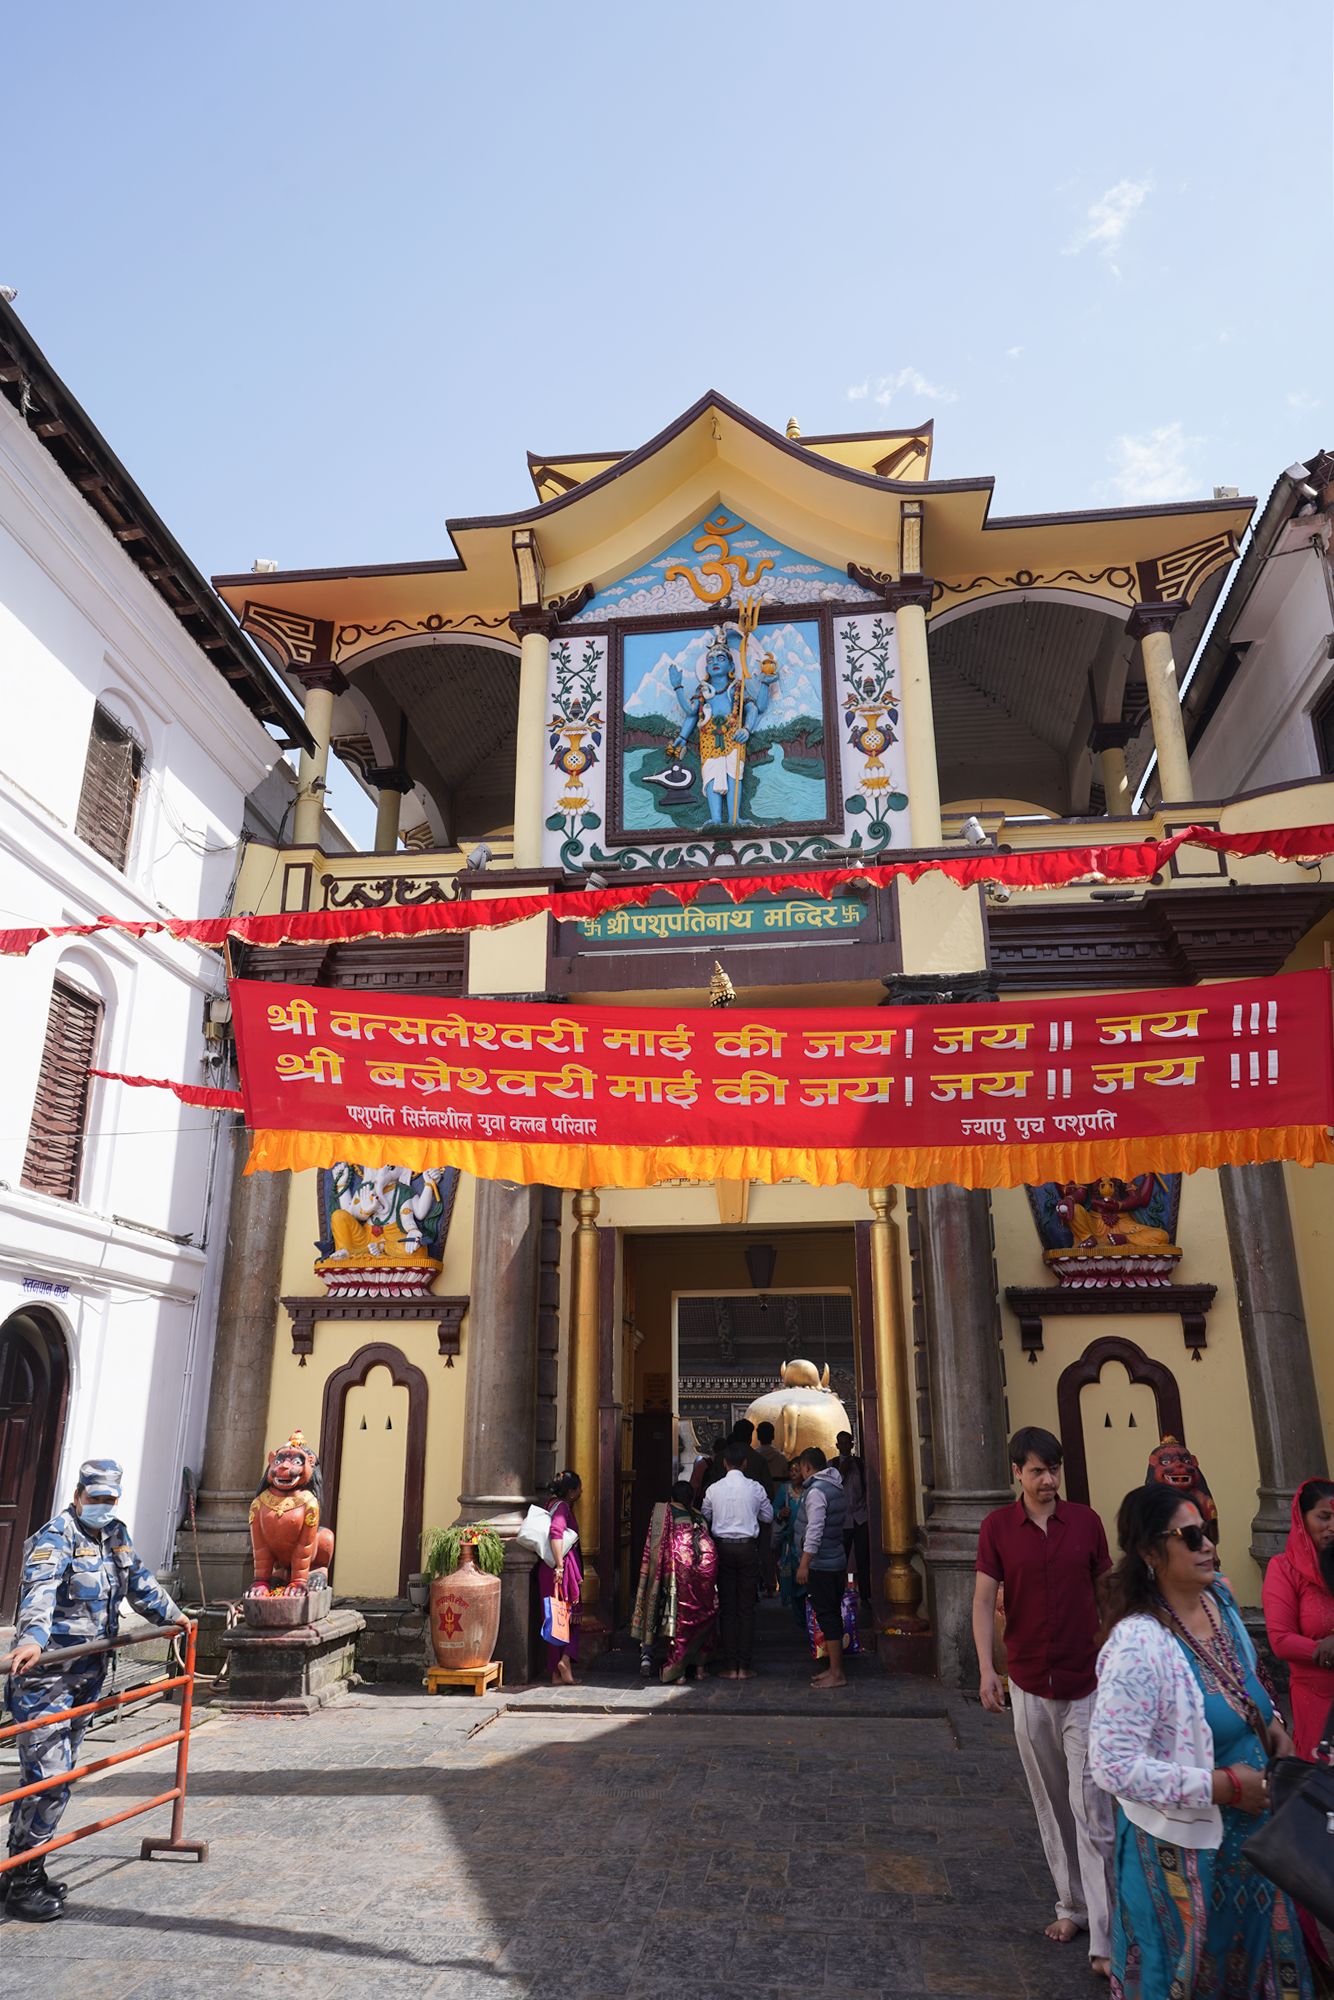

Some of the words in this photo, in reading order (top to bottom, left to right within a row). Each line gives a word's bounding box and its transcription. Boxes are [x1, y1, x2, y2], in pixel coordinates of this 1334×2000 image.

[764, 900, 839, 928] मन्दिर
[267, 998, 318, 1036] श्री
[329, 1010, 588, 1054] वत्सलेश्वरी
[602, 1023, 695, 1061] माई
[713, 1023, 788, 1058] की
[275, 1046, 345, 1085] श्री
[365, 1056, 598, 1100] बज्रेश्वरी
[606, 1068, 702, 1110] माई
[712, 1069, 790, 1106] की
[346, 1103, 395, 1130] पशुपति
[477, 1112, 506, 1136] युवा
[510, 1115, 547, 1133] क्लब
[551, 1112, 598, 1137] परिवार
[1014, 1117, 1046, 1140] पुच
[1052, 1108, 1118, 1137] पशुपति
